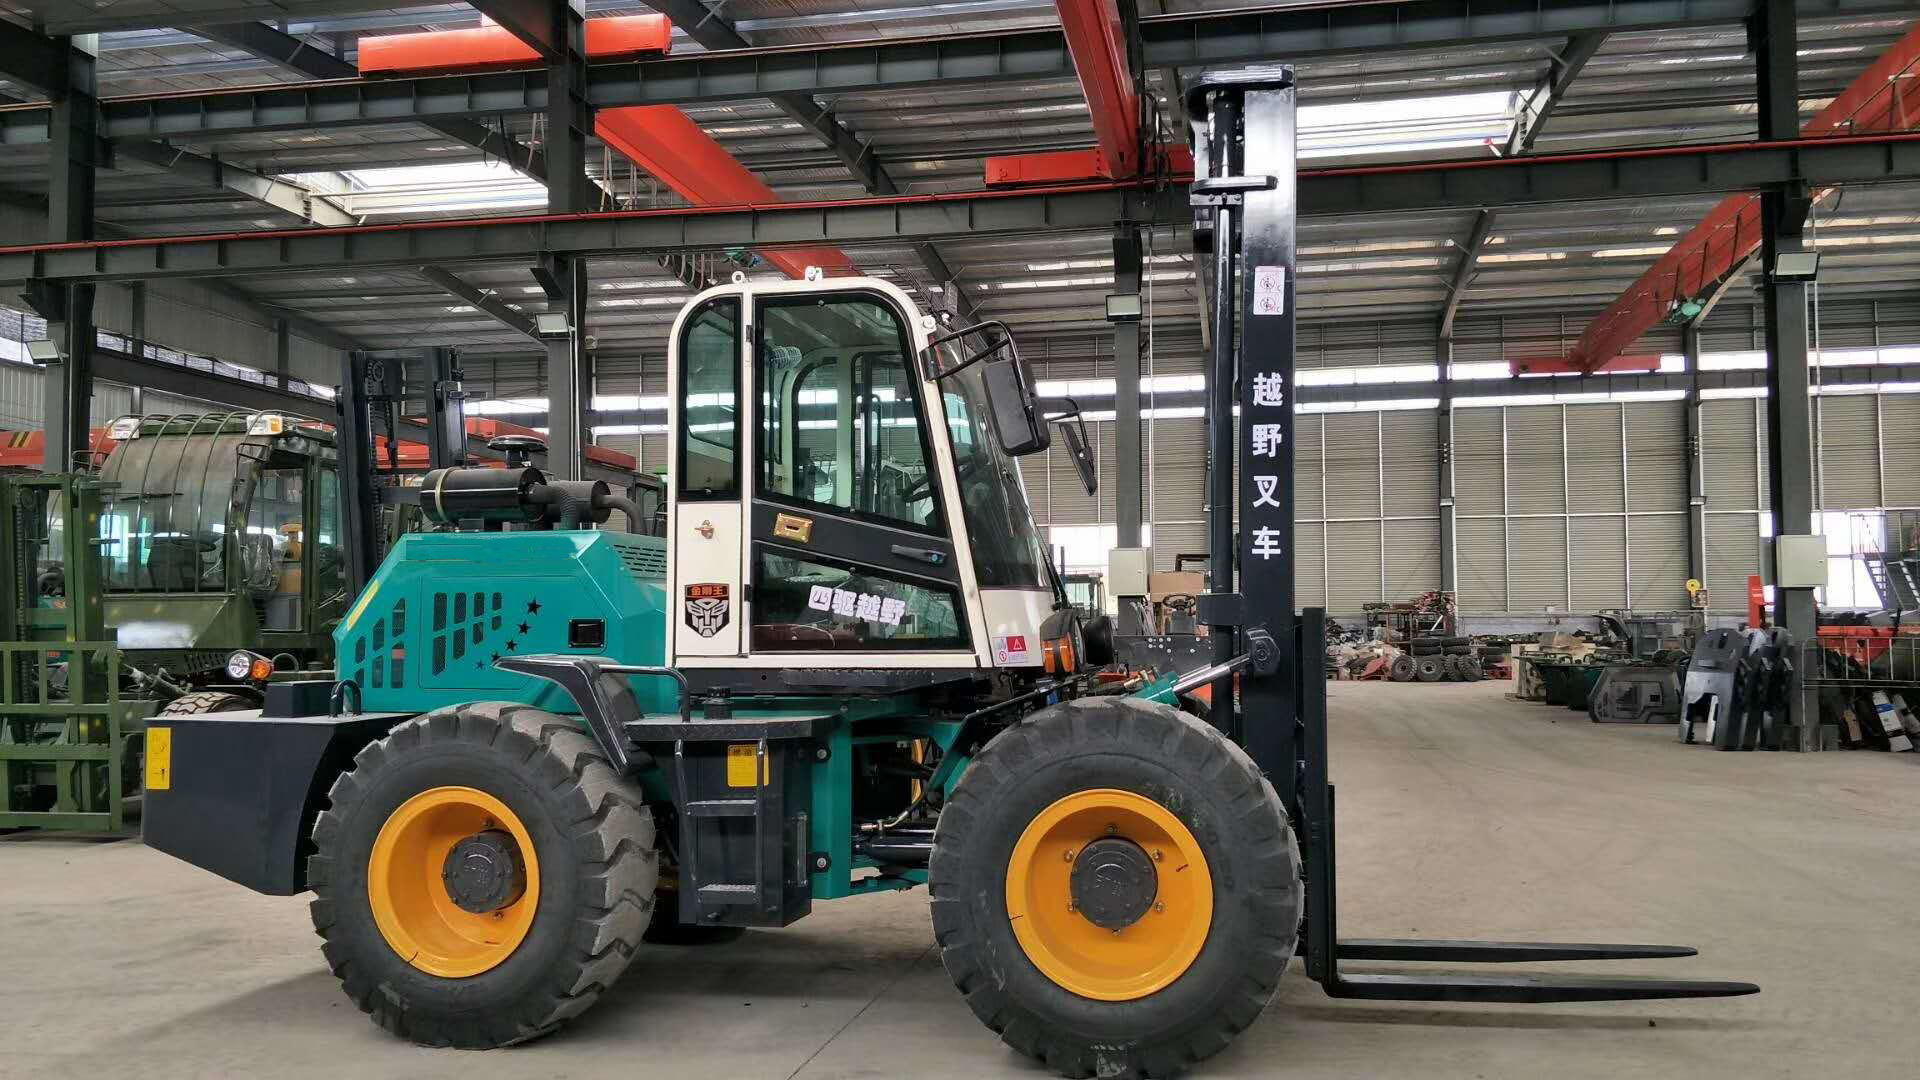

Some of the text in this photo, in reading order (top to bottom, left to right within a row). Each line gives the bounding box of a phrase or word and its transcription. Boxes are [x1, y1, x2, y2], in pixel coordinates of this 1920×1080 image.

[1252, 372, 1283, 560] 越野叉车
[808, 585, 905, 626] 四驱越野
